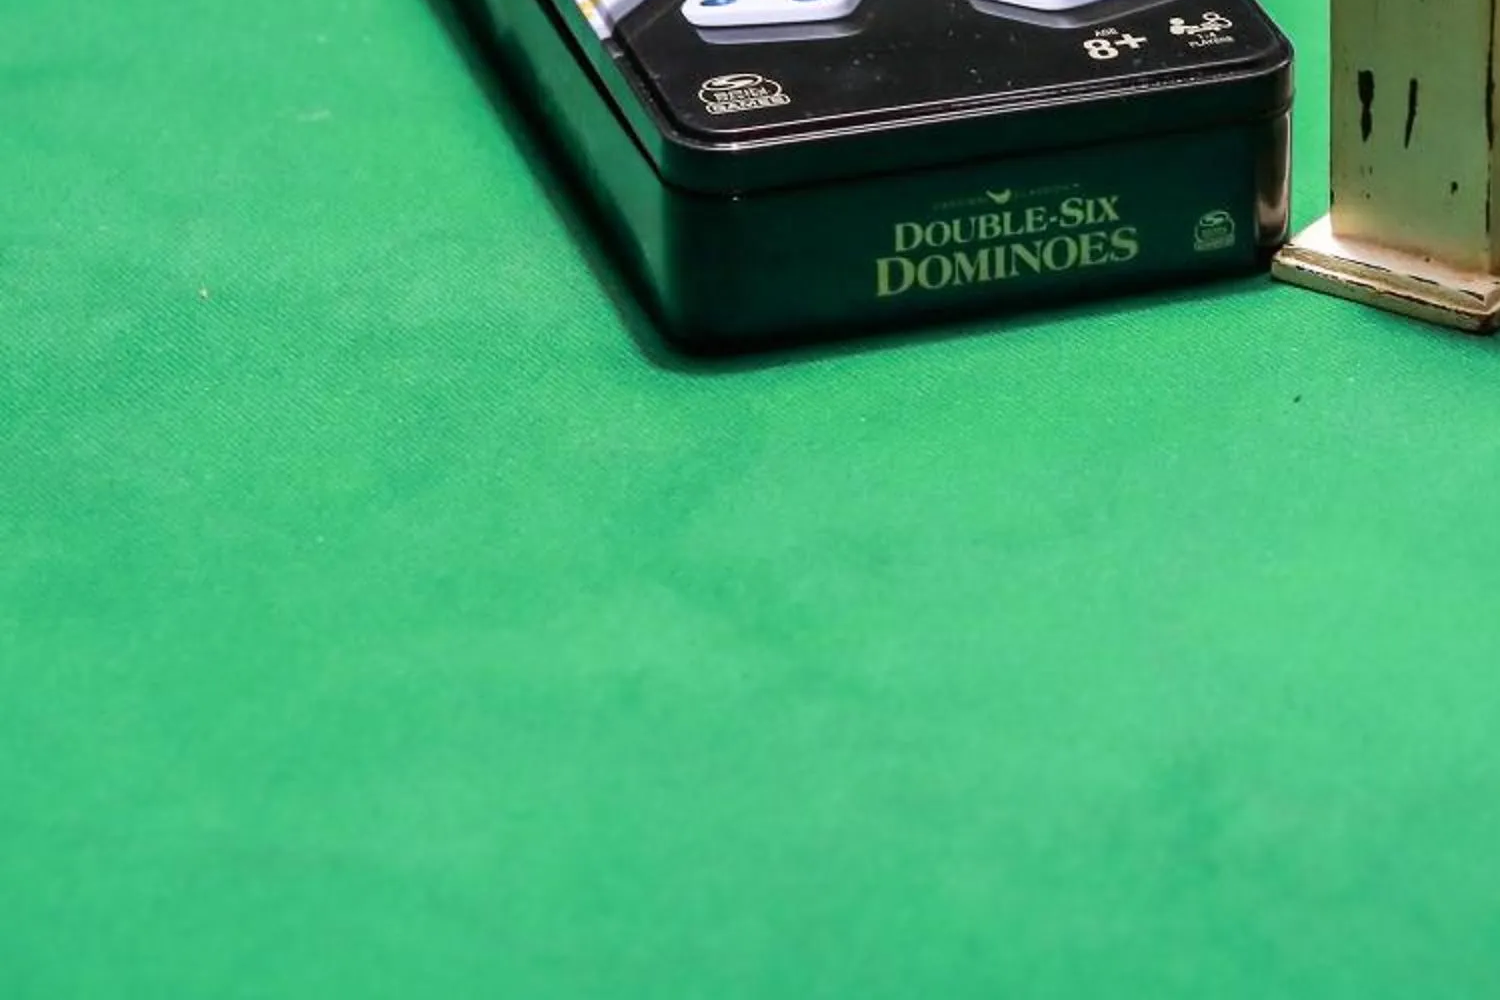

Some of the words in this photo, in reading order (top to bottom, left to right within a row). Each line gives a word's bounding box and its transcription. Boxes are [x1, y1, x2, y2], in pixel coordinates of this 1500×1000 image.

[1083, 33, 1147, 59] 8+
[894, 195, 1120, 252] DOUBLE-SIX
[876, 226, 1139, 297] DOMINOES
